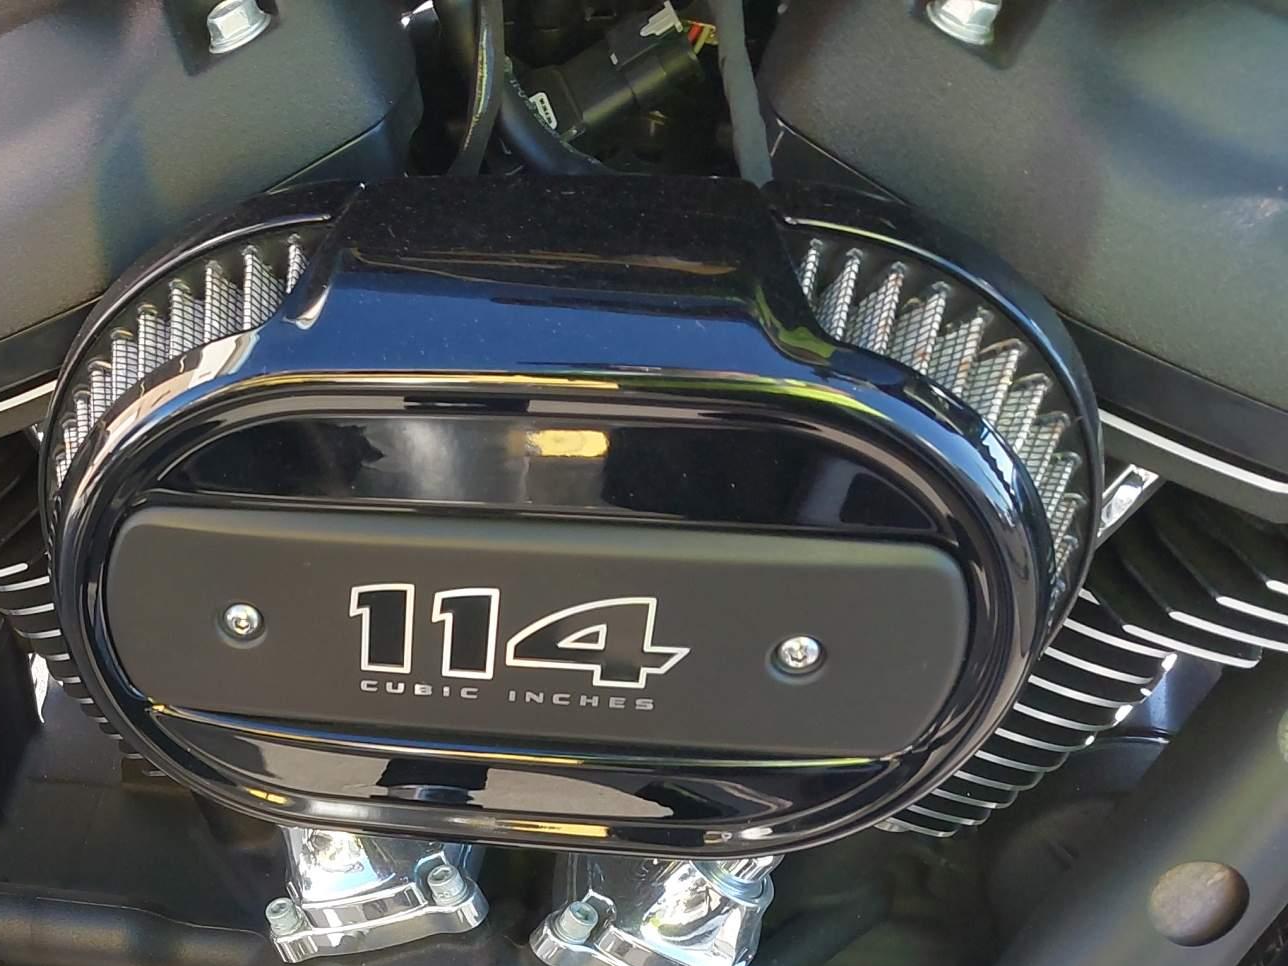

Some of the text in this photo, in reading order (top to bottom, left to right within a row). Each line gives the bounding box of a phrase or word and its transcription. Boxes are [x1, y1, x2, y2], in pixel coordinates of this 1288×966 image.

[349, 583, 692, 689] 114
[360, 679, 655, 711] CUBIC INCHES
